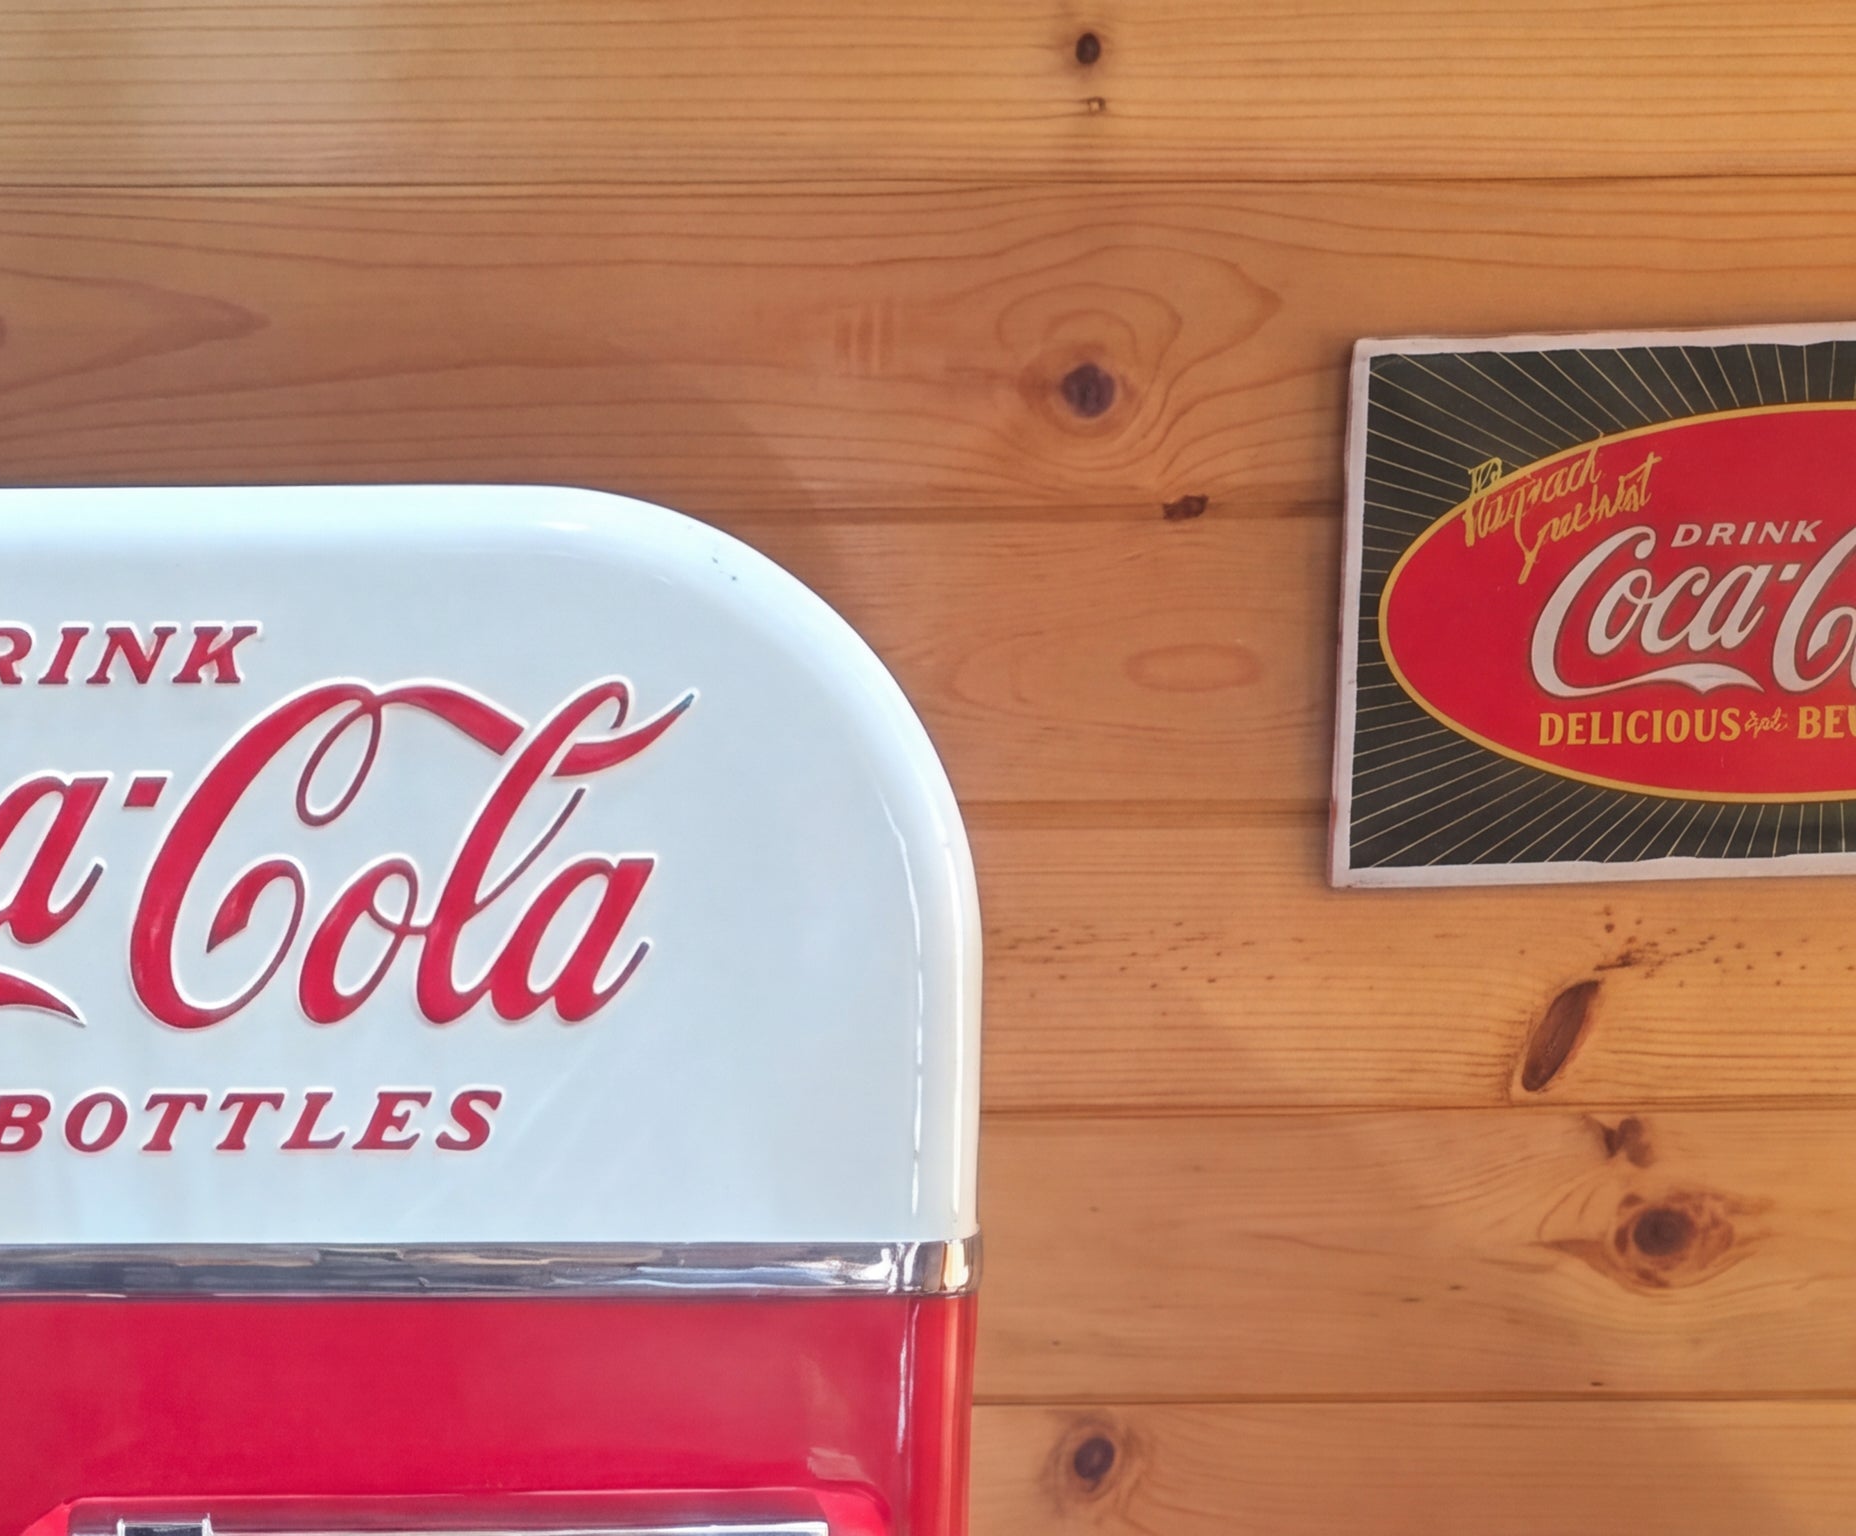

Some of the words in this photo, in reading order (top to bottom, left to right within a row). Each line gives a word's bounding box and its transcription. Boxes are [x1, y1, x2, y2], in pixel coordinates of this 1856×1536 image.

[1670, 520, 1824, 549] DRINK
[1530, 525, 1856, 697] Coca-C
[1539, 707, 1741, 746] DELICIOUS
